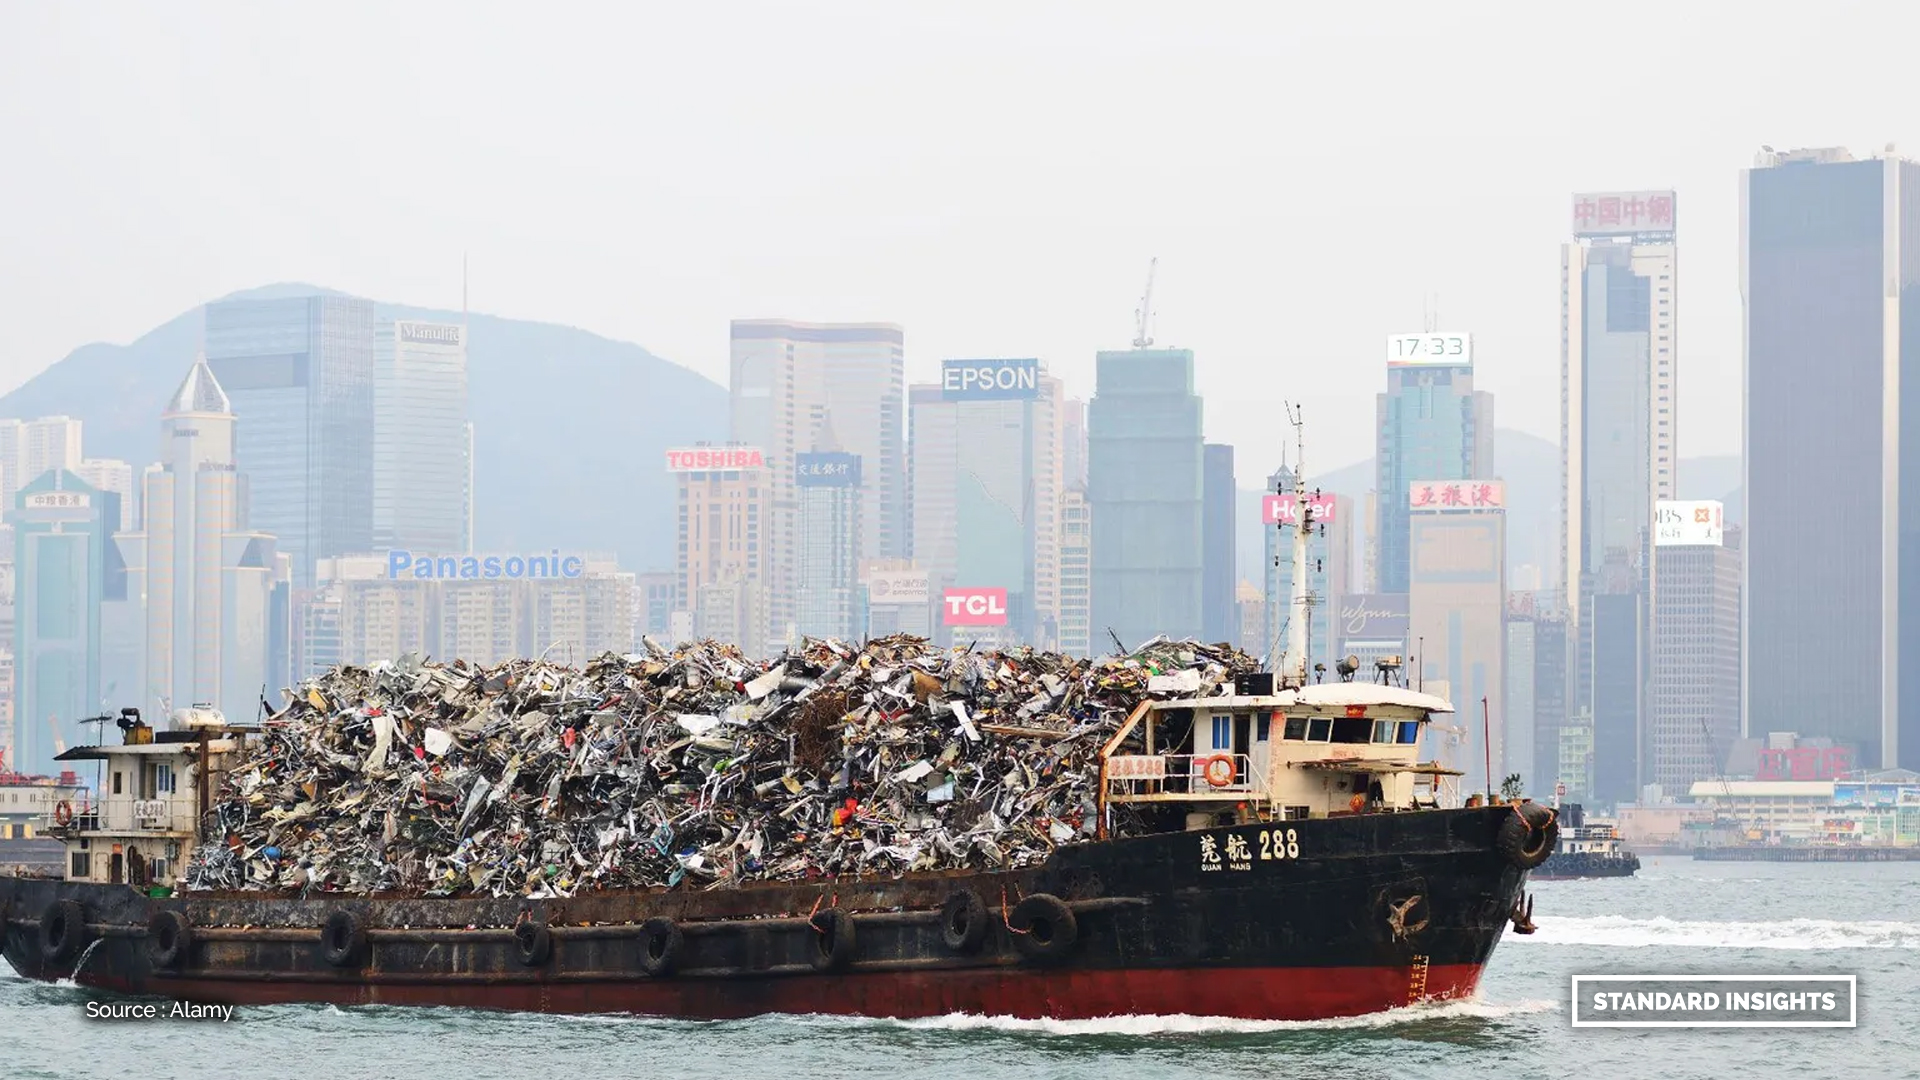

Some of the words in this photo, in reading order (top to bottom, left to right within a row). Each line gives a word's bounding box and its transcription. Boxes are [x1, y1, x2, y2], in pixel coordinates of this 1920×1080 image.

[1574, 196, 1671, 227] 中国中钢
[403, 324, 460, 342] Manulife
[1396, 338, 1463, 356] 17:33
[944, 367, 1035, 391] EPSON
[667, 450, 763, 468] TOSHIBA
[389, 549, 581, 579] Panasonic
[945, 595, 1005, 616] TCL
[1259, 828, 1299, 860] 288
[1229, 862, 1251, 872] HANG
